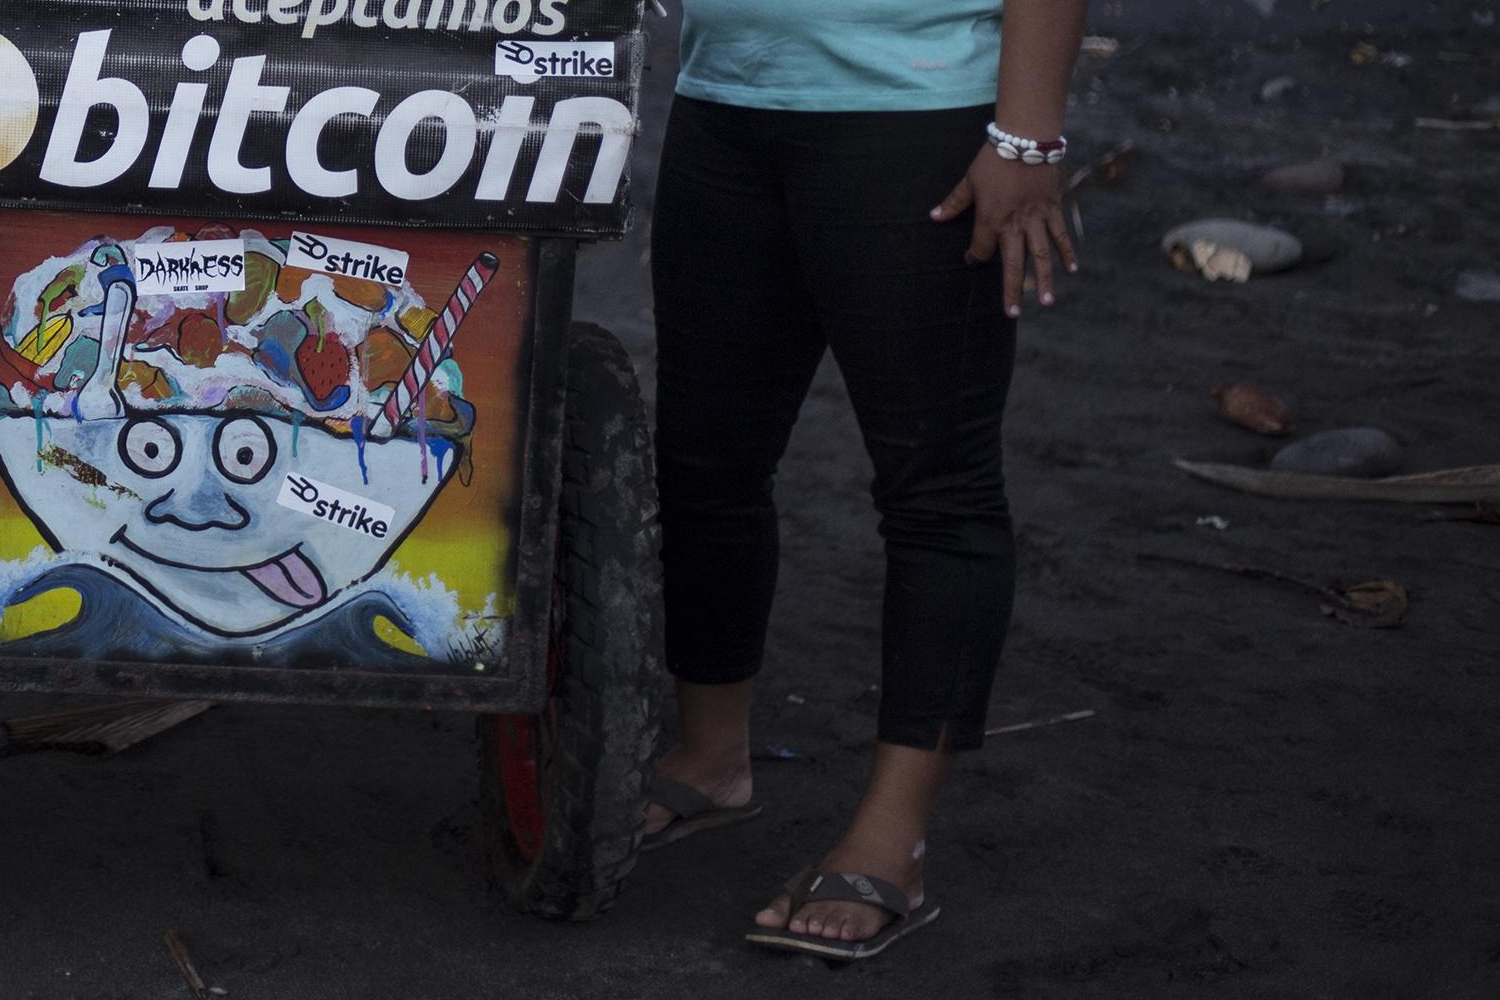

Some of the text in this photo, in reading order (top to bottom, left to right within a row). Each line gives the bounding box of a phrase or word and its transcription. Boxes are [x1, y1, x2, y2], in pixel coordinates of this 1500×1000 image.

[534, 51, 612, 75] strike
[39, 28, 635, 204] bitcoin
[325, 252, 403, 284] strike
[313, 500, 387, 538] strike
